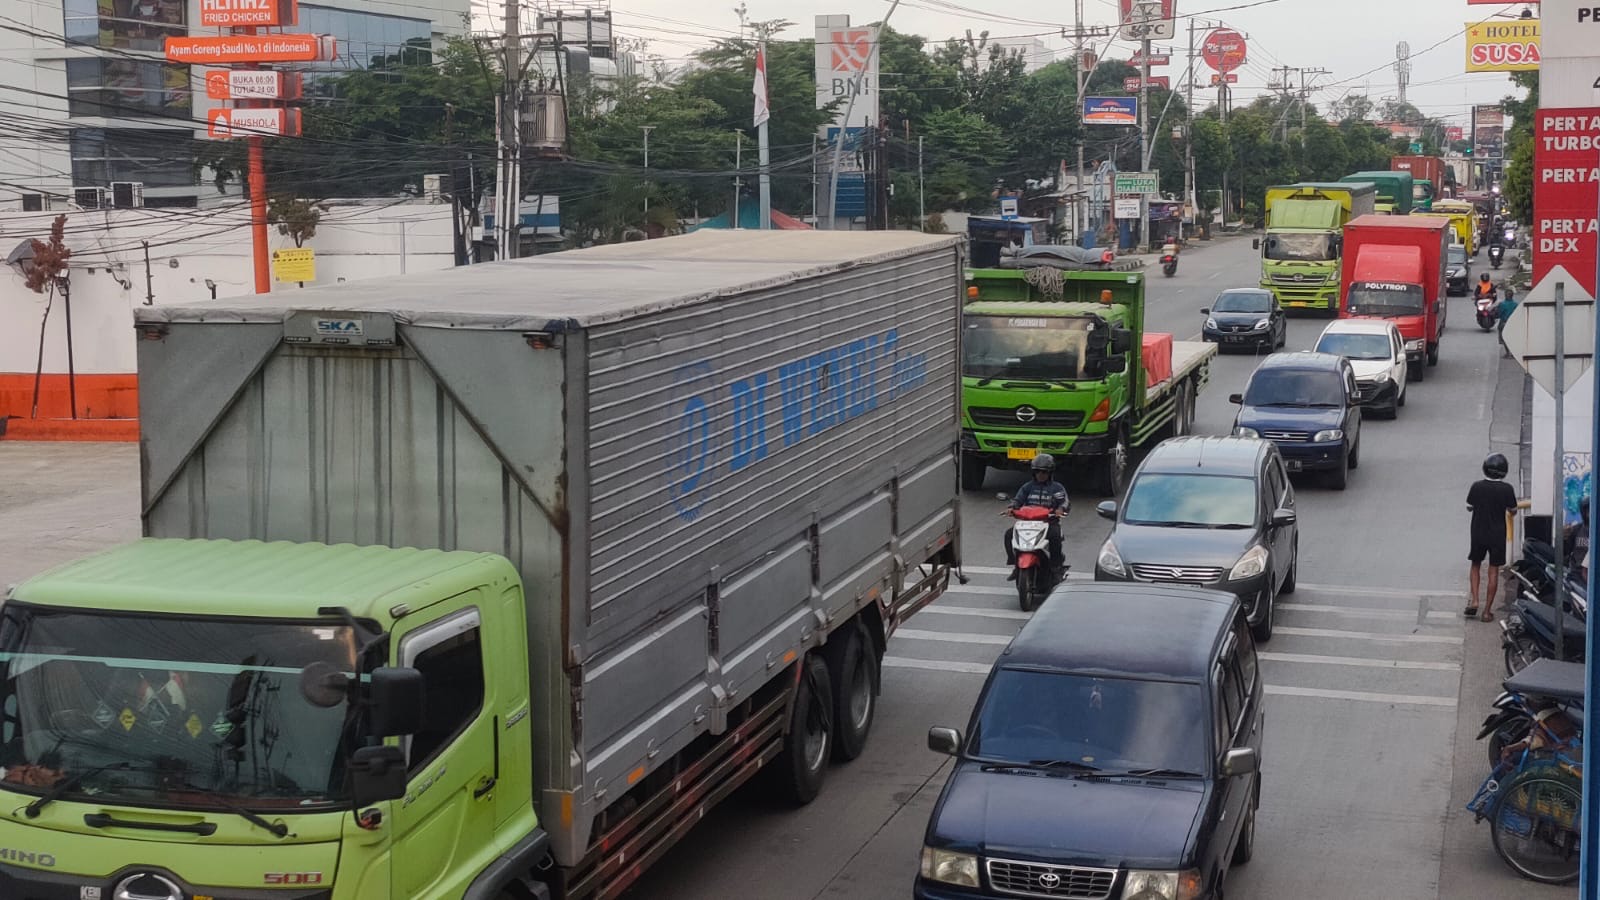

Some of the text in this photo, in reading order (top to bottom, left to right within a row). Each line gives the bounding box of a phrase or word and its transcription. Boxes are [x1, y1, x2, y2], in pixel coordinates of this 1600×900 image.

[204, 12, 270, 22] FRIED CHICKEN
[1487, 26, 1540, 37] HOTEL
[170, 45, 191, 56] Ayam
[192, 44, 220, 56] Goreng
[222, 42, 244, 54] Saudi
[263, 42, 271, 52] di
[272, 41, 310, 52] Indonesia
[1472, 43, 1540, 64] SUSA
[233, 76, 253, 84] BUKA
[832, 78, 869, 95] BNI
[1540, 238, 1579, 252] DEX
[1365, 283, 1407, 291] POLYTRON
[318, 321, 360, 331] SKA
[264, 872, 322, 885] 500
